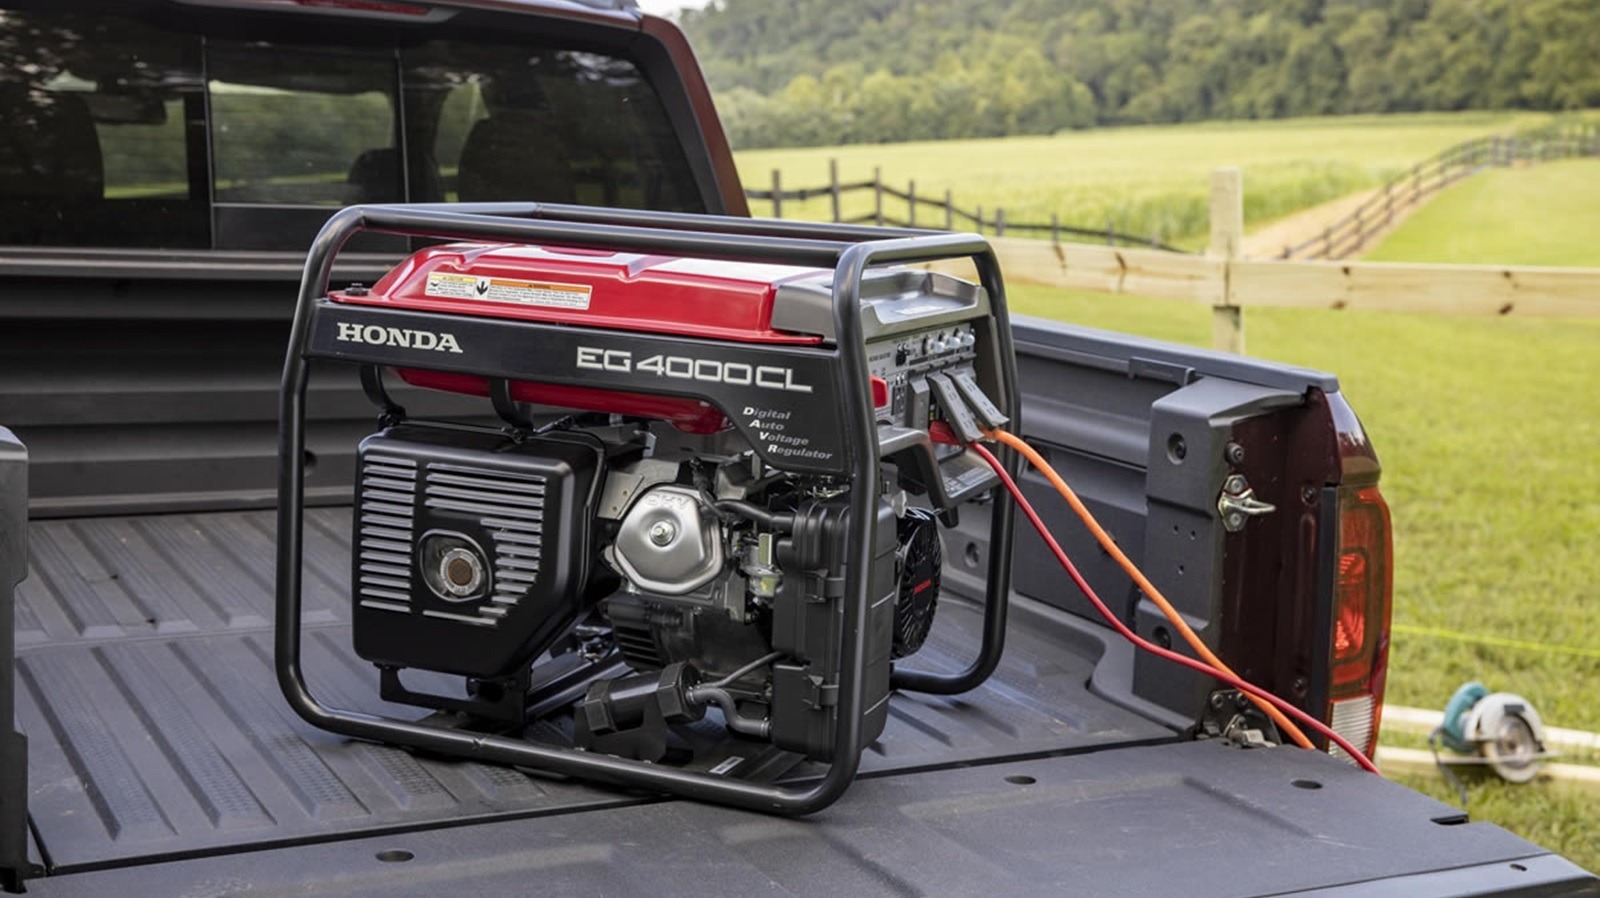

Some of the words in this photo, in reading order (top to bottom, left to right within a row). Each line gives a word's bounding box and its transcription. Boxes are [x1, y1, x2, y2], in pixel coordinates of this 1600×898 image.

[337, 322, 463, 353] HONDA
[743, 406, 791, 419] Digital
[748, 419, 784, 430] Auto
[760, 431, 809, 446] Voltage
[767, 444, 832, 459] Regulator
